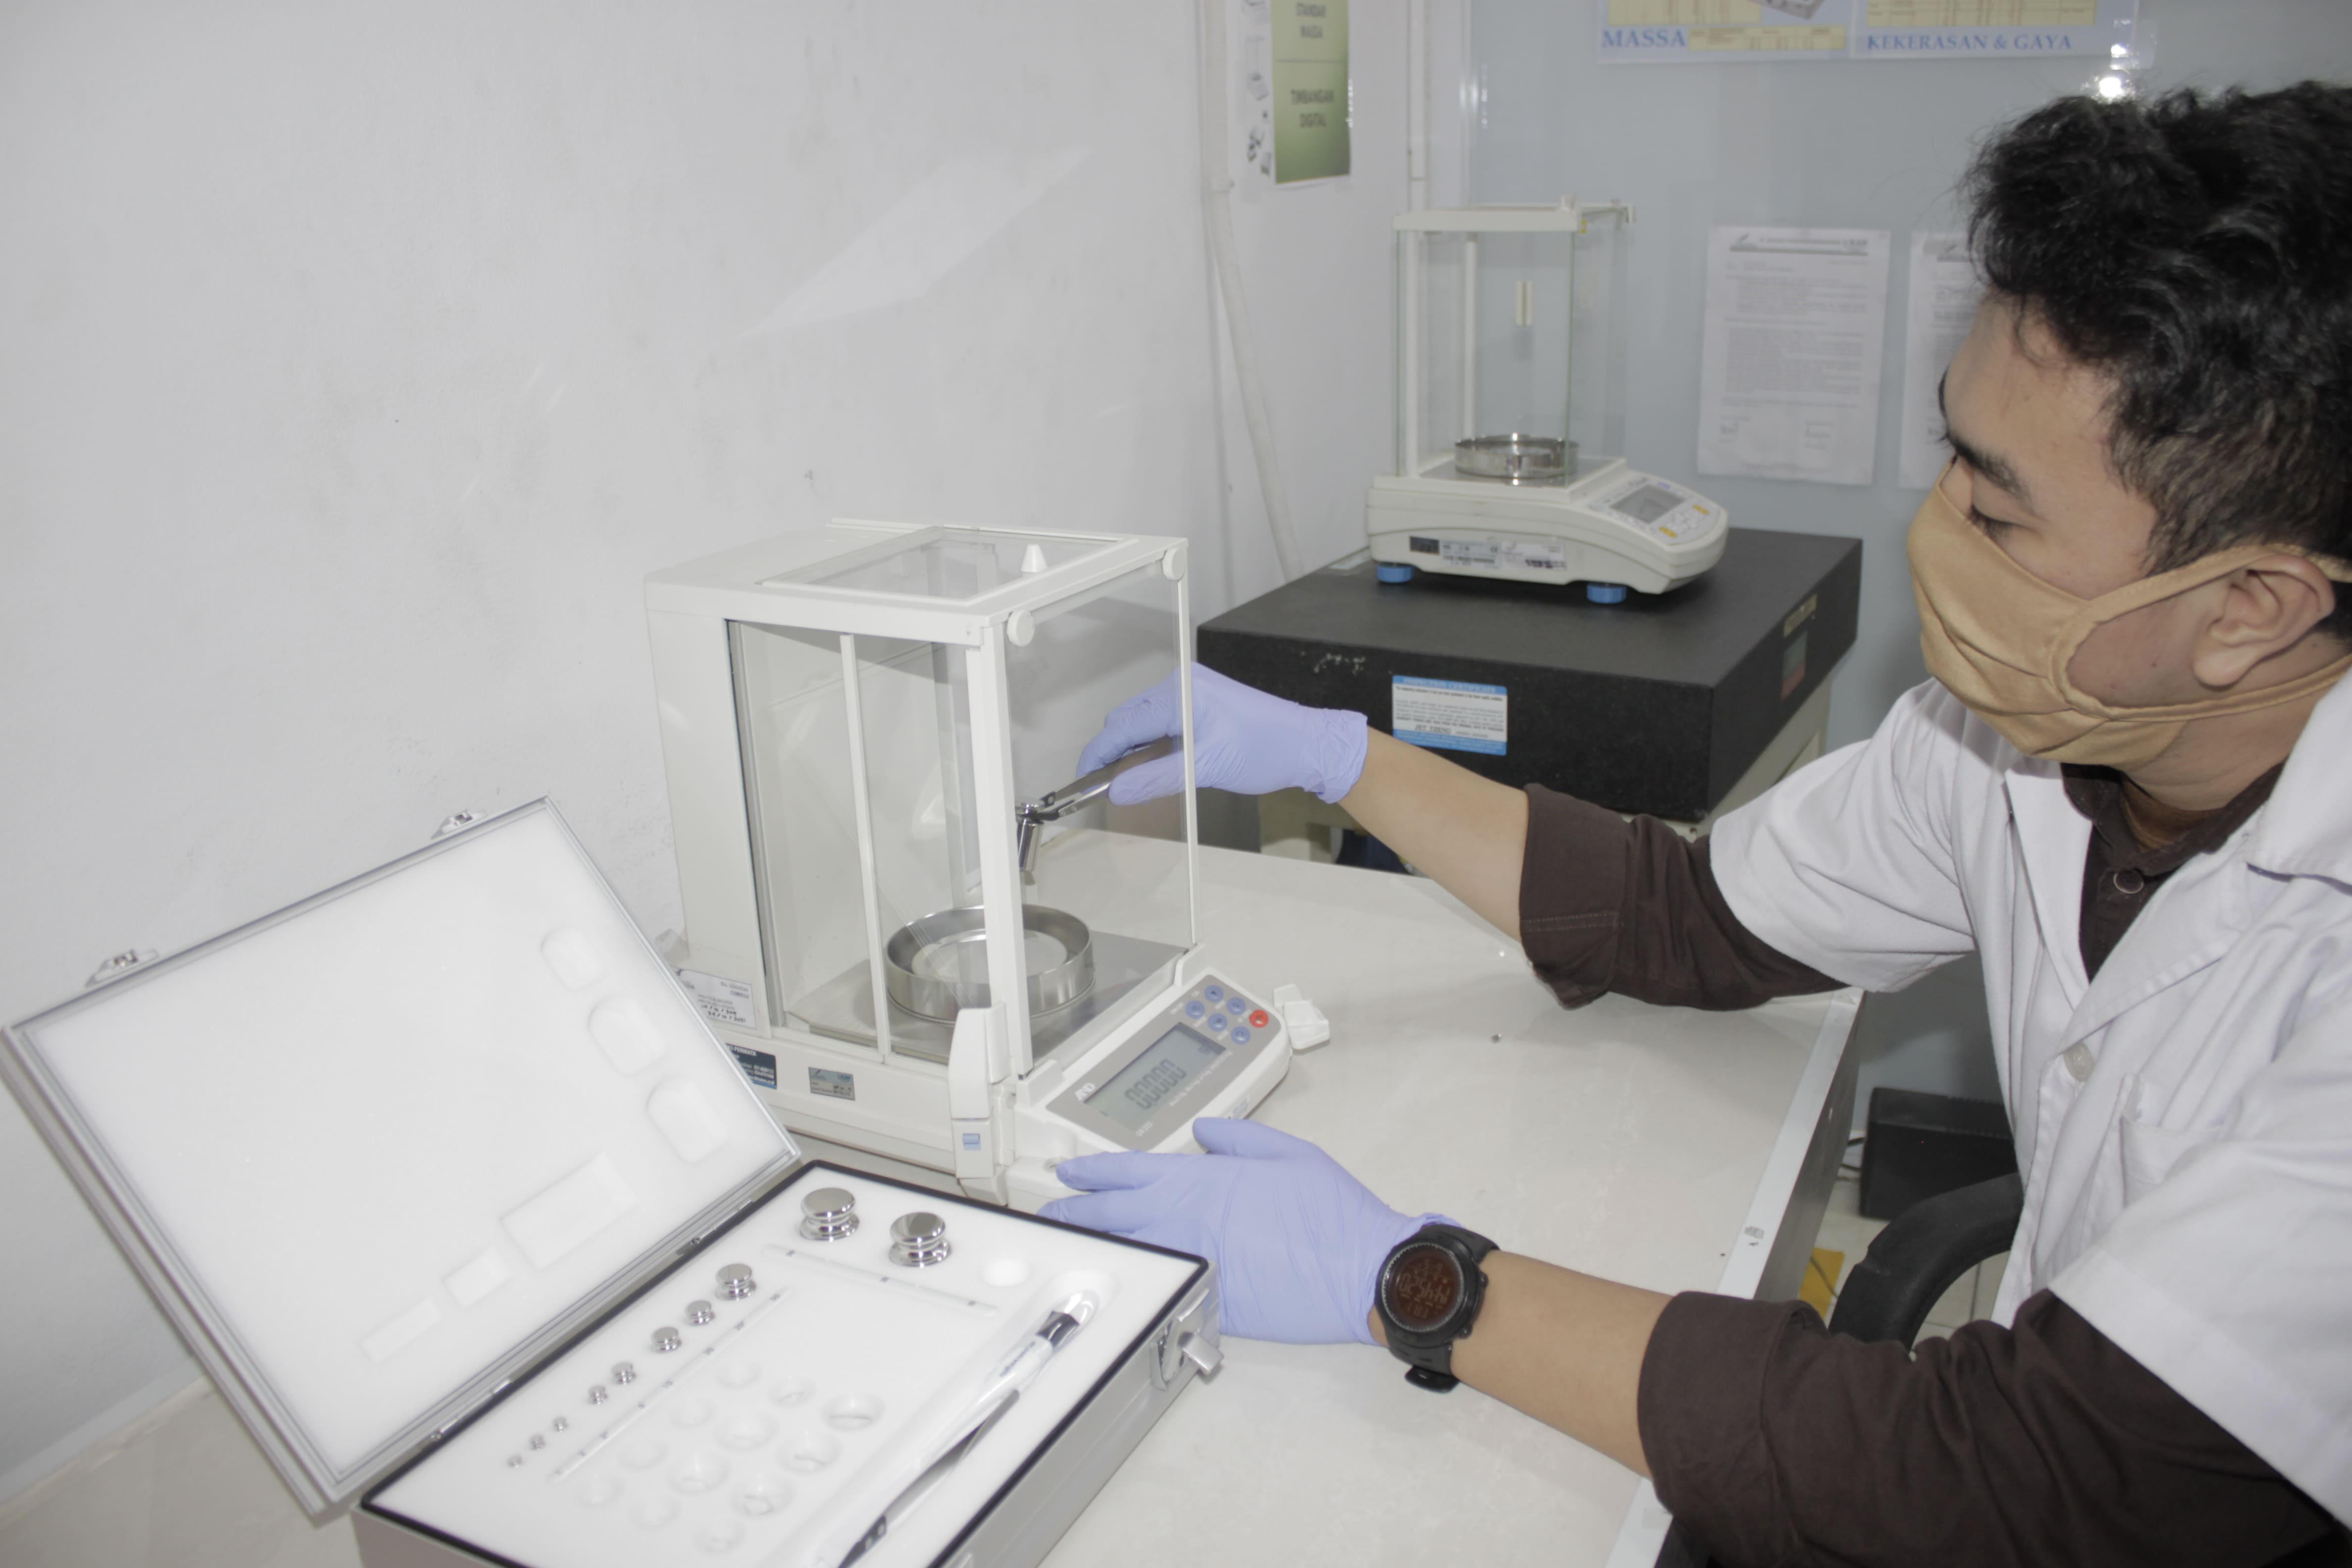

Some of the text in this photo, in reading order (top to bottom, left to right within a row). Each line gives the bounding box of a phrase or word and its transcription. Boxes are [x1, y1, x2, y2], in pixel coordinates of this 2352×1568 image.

[1602, 29, 1687, 48] MASSA
[1866, 34, 2072, 50] KEKERASAN & GAYA
